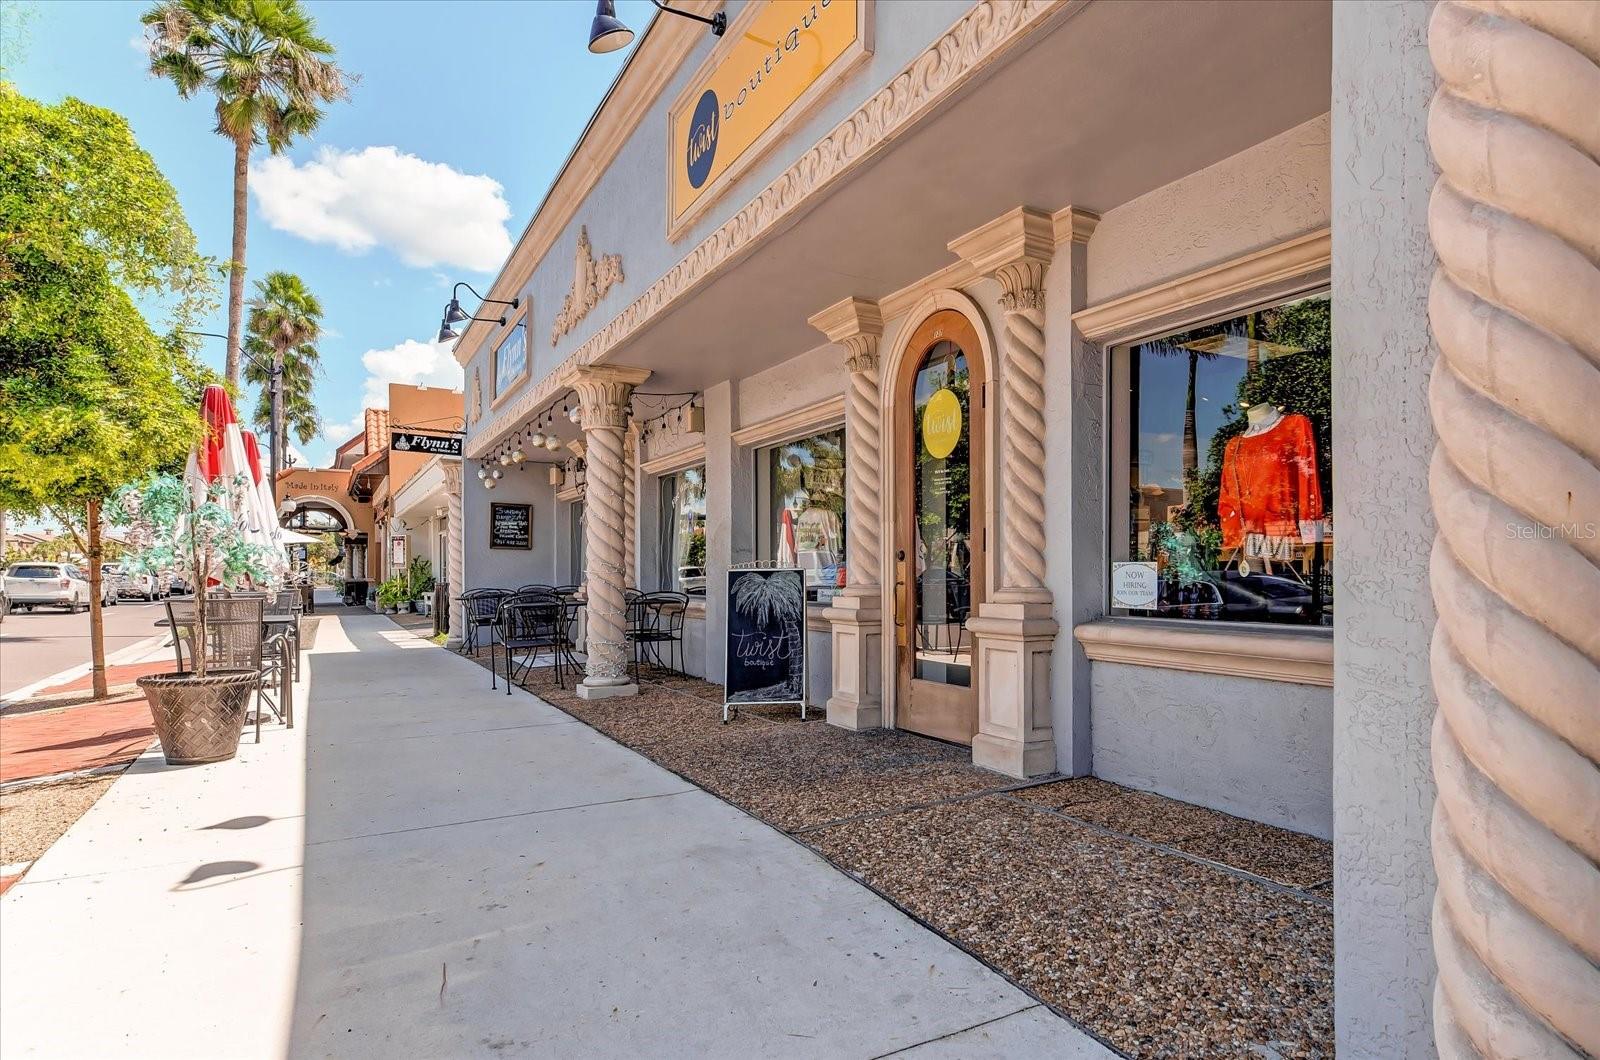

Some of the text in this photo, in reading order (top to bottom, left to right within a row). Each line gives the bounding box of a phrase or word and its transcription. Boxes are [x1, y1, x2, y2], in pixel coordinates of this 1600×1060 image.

[411, 435, 460, 450] Flynn's
[1125, 570, 1145, 579] NOW
[1123, 581, 1147, 589] HIRING
[731, 628, 794, 660] twist
[744, 658, 775, 671] boutique
